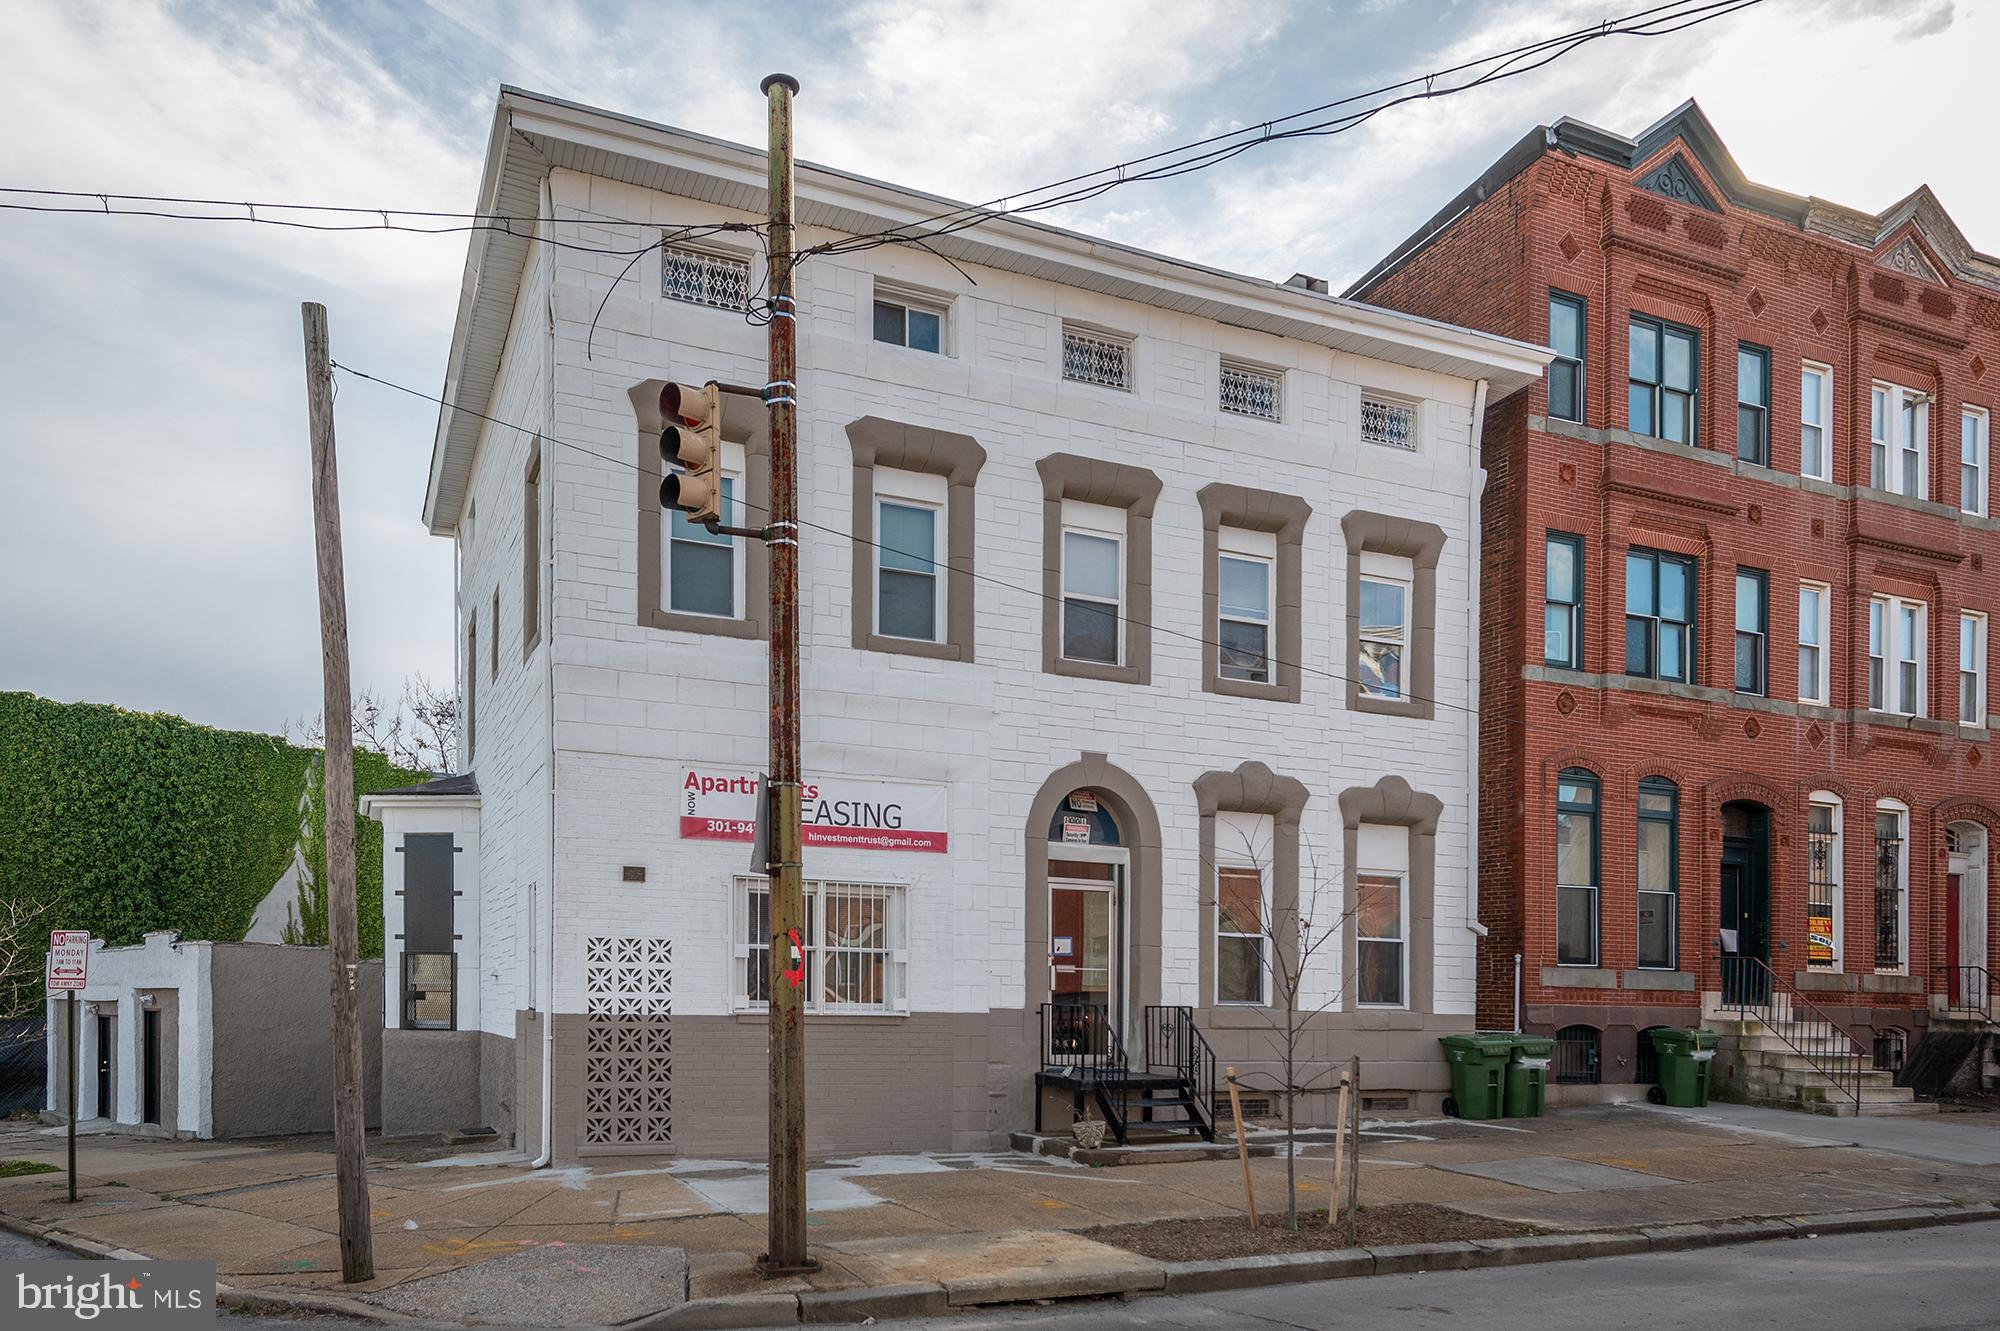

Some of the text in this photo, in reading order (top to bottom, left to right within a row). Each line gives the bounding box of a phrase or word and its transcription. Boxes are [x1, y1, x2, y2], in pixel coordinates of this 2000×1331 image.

[684, 771, 818, 799] Apartts
[687, 791, 696, 816] NOW
[1071, 799, 1081, 808] NO
[801, 799, 902, 829] EASING
[707, 820, 756, 834] 301-94
[808, 832, 932, 847] hinvestmenttrust@gmail.com
[53, 933, 87, 945] NO PARKING
